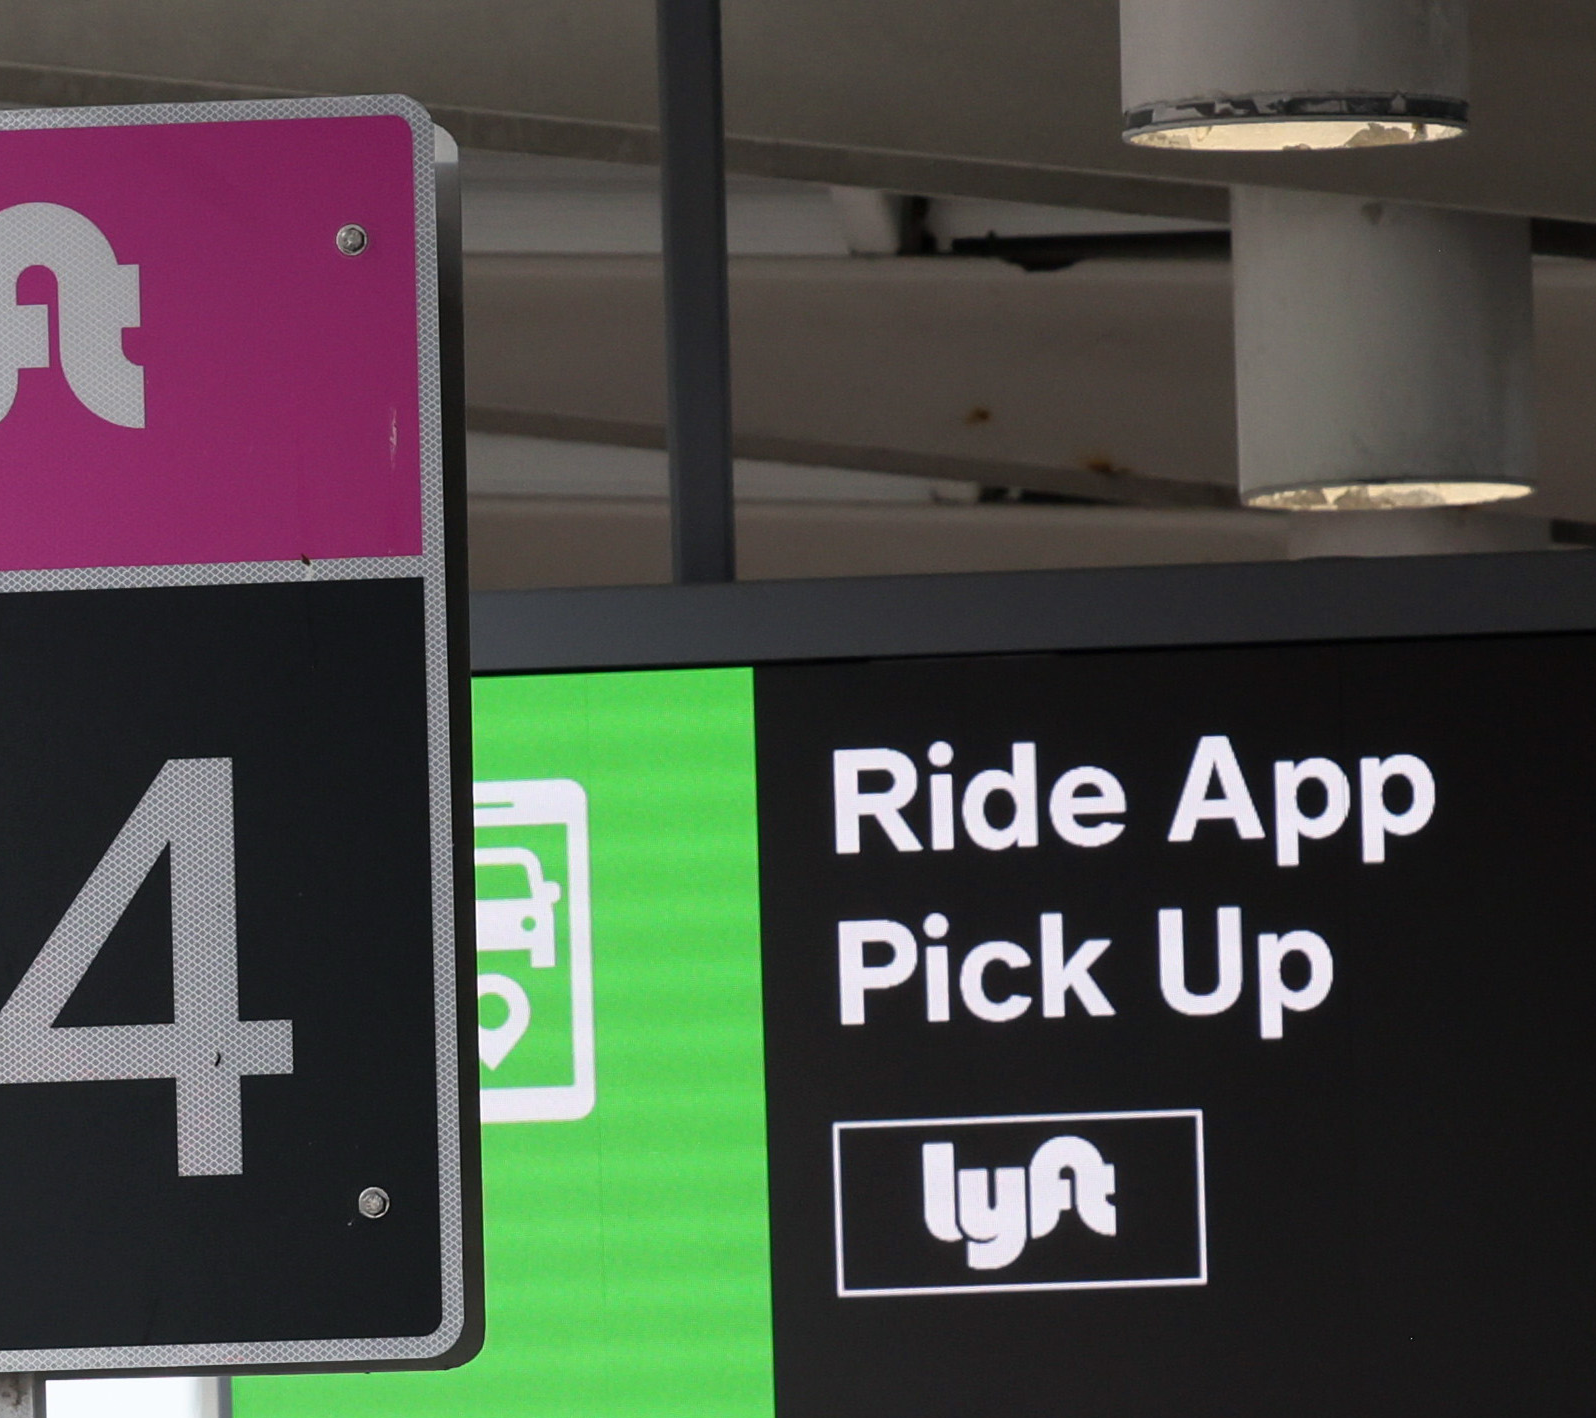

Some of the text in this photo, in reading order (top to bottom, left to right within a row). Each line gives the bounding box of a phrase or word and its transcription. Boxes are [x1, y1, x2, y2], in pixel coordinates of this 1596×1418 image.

[832, 734, 1437, 867] Ride App
[837, 905, 1335, 1040] Pick Up
[921, 1134, 1117, 1270] lyft
